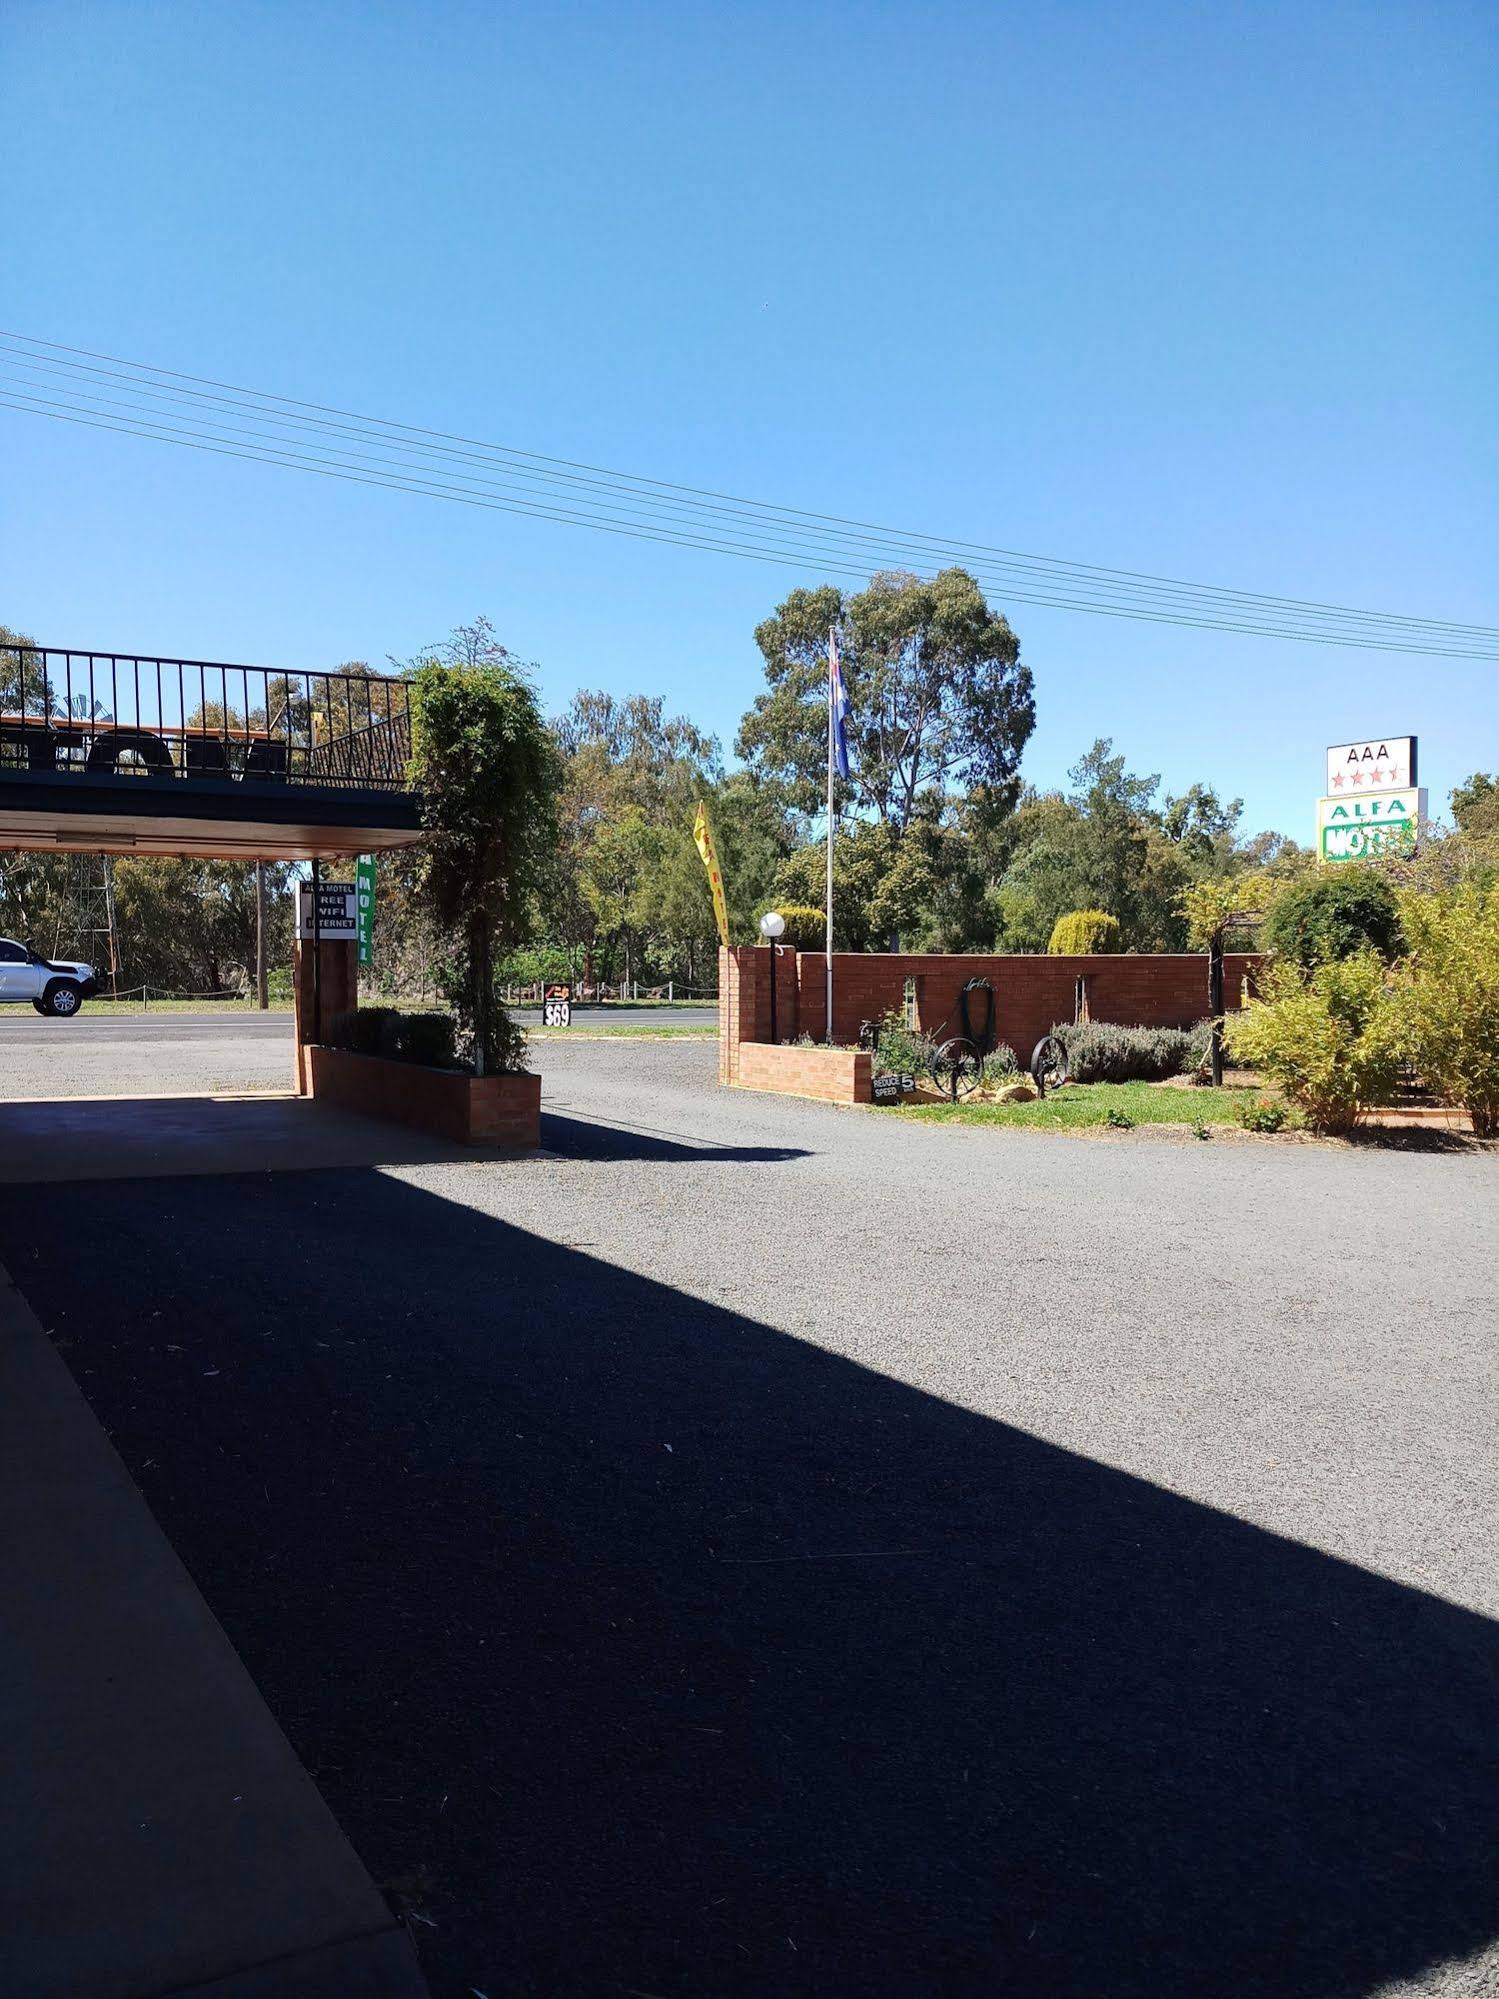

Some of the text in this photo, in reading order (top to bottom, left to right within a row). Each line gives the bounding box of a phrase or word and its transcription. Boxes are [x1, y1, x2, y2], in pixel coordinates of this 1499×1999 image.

[1347, 744, 1389, 764] AAA
[1331, 799, 1406, 819] ALFA
[305, 884, 353, 893] ALA MOTEL
[320, 896, 344, 905] REE
[359, 876, 370, 960] MOTEL
[545, 1004, 569, 1027] $69
[873, 1077, 900, 1088] REDUCE
[902, 1075, 914, 1088] 5
[875, 1087, 897, 1097] SPEED
